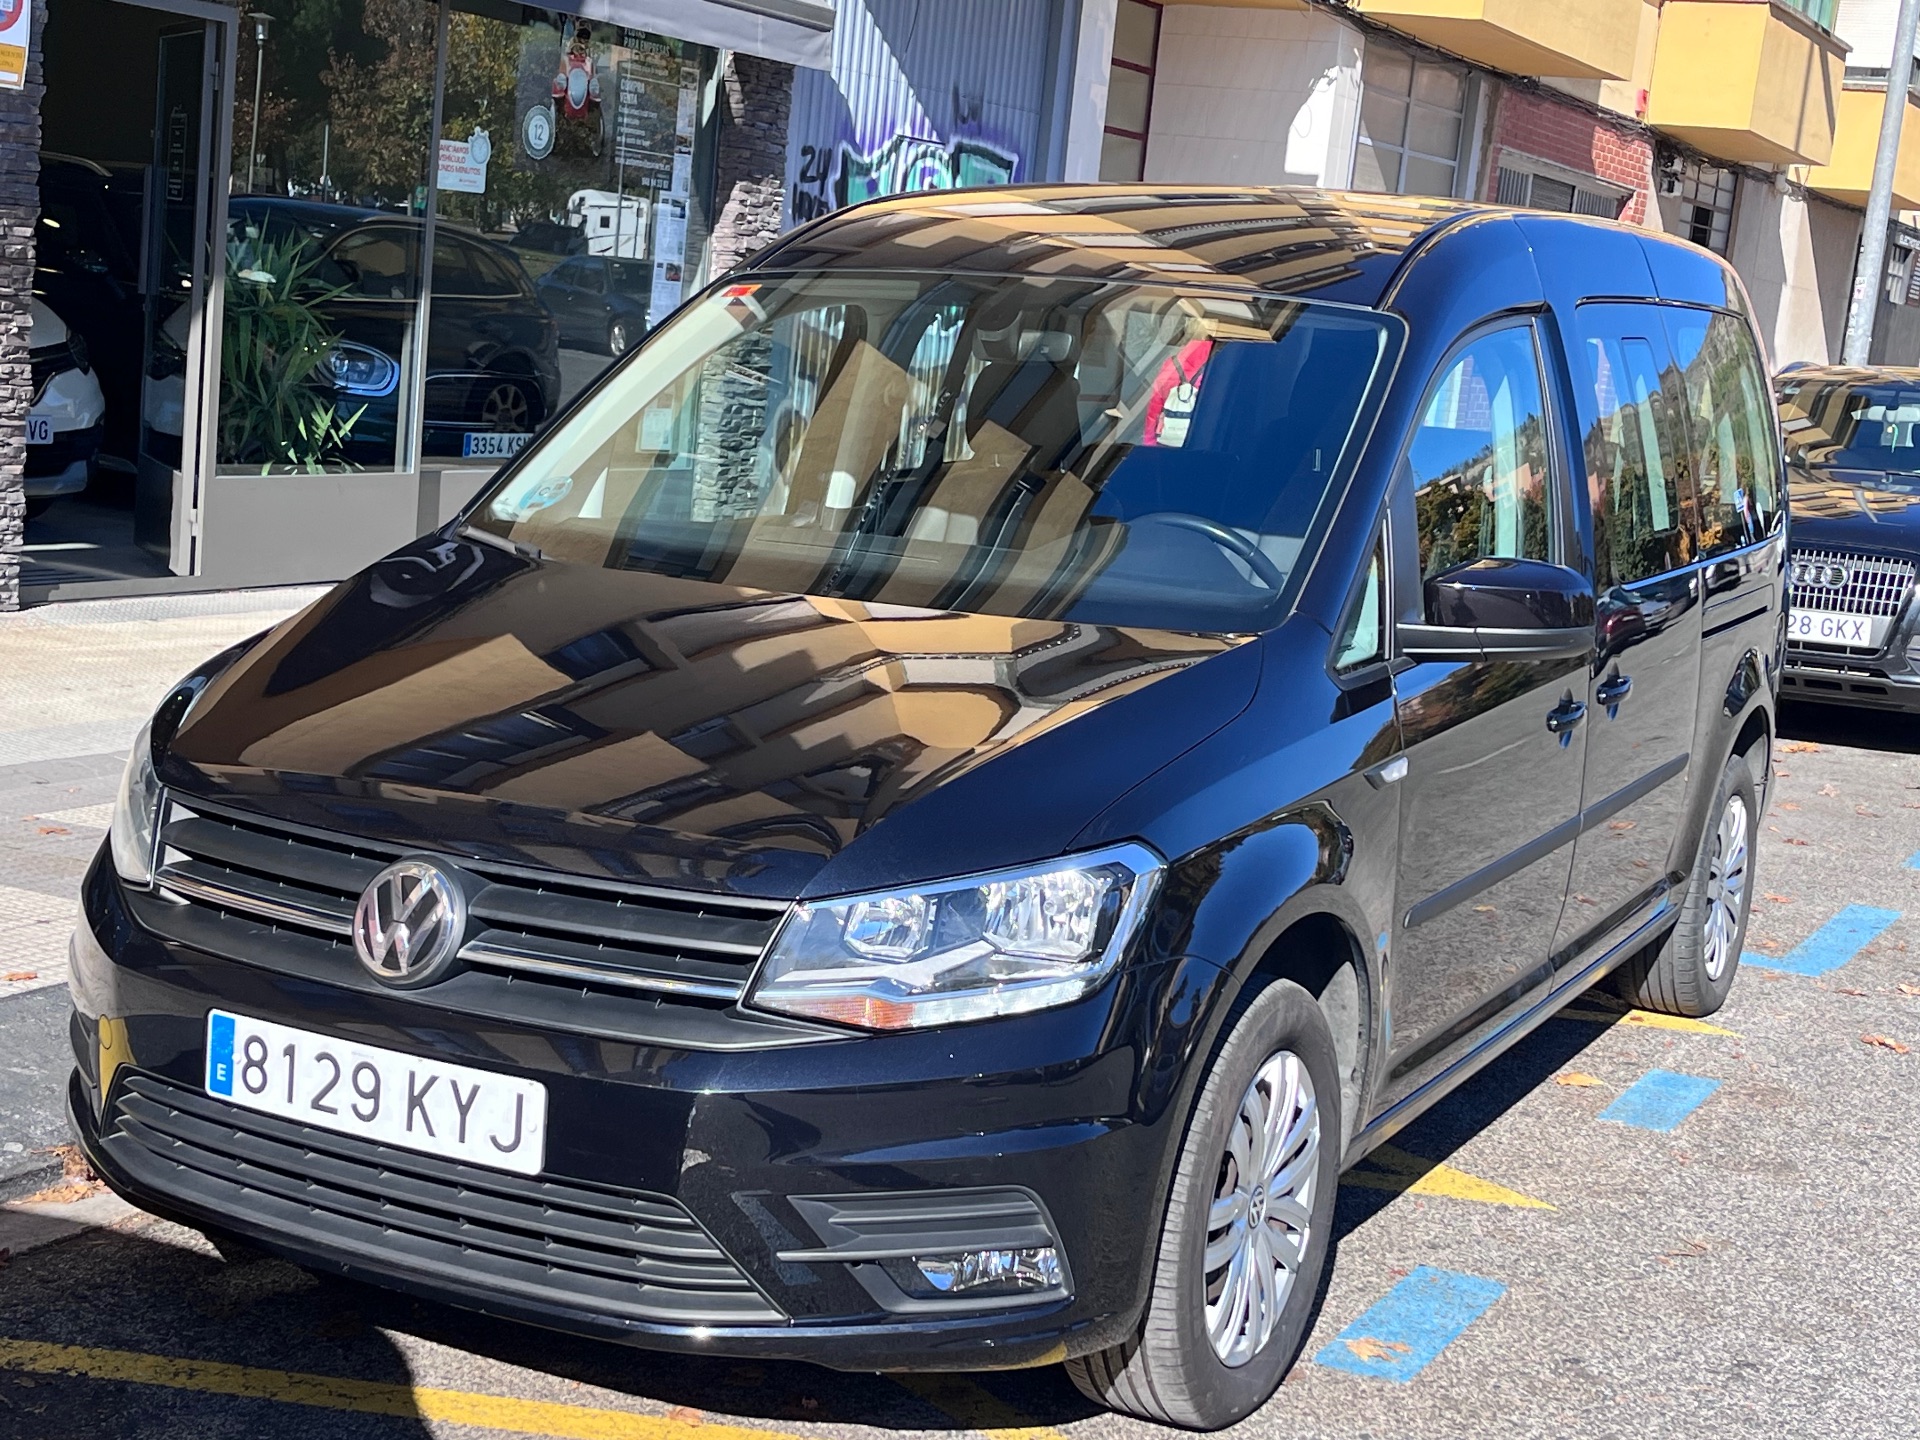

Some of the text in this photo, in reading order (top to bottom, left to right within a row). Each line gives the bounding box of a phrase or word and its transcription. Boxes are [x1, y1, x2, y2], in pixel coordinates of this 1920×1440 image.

[534, 124, 544, 141] 12
[28, 419, 48, 441] VG
[471, 436, 503, 455] 3354
[1821, 617, 1864, 641] GKX
[216, 1063, 227, 1081] E
[241, 1034, 525, 1153] 8129 KYJ
